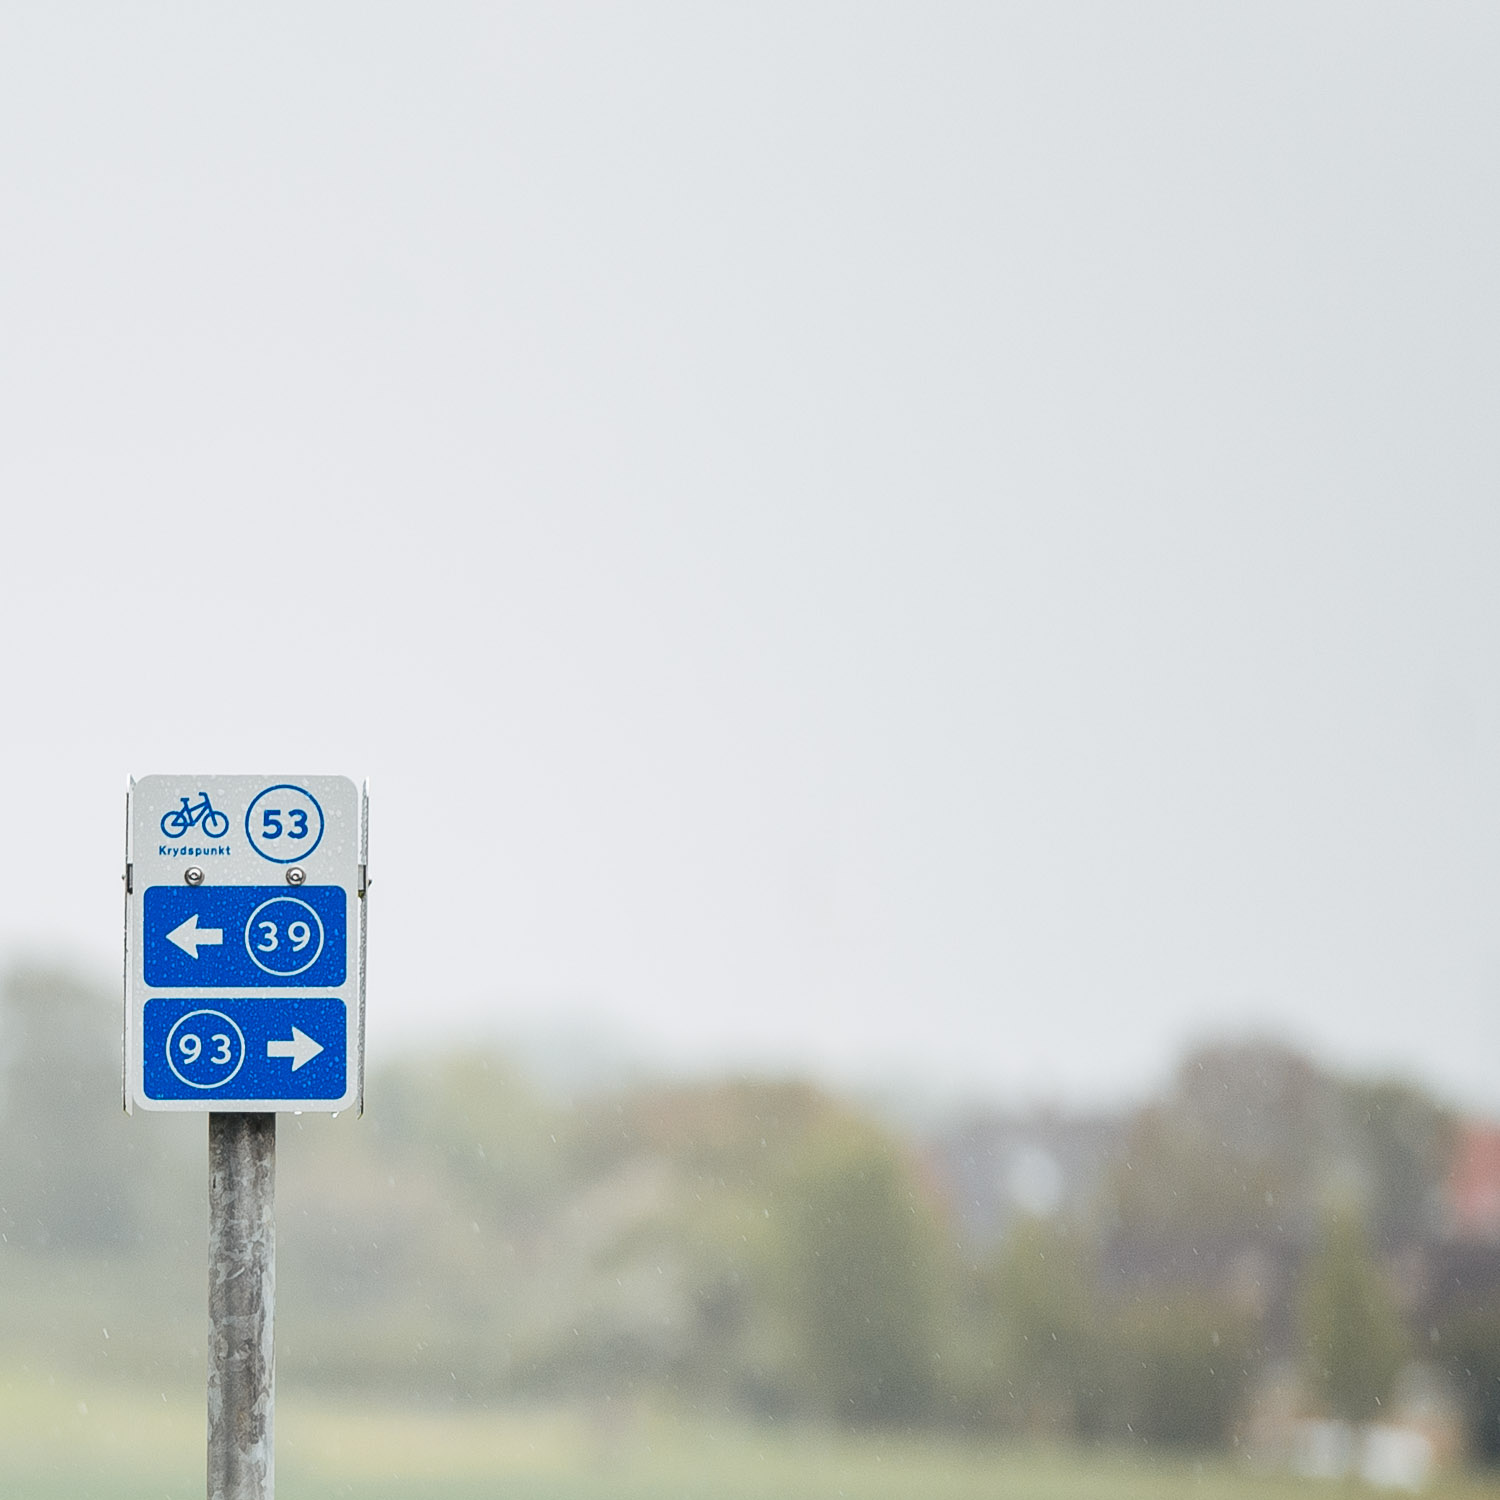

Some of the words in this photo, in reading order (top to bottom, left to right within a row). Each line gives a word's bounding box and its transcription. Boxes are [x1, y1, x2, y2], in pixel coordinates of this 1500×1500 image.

[262, 809, 309, 839] 53
[158, 845, 231, 857] Krydspunkt
[257, 921, 311, 952] 39
[178, 1034, 232, 1065] 93
